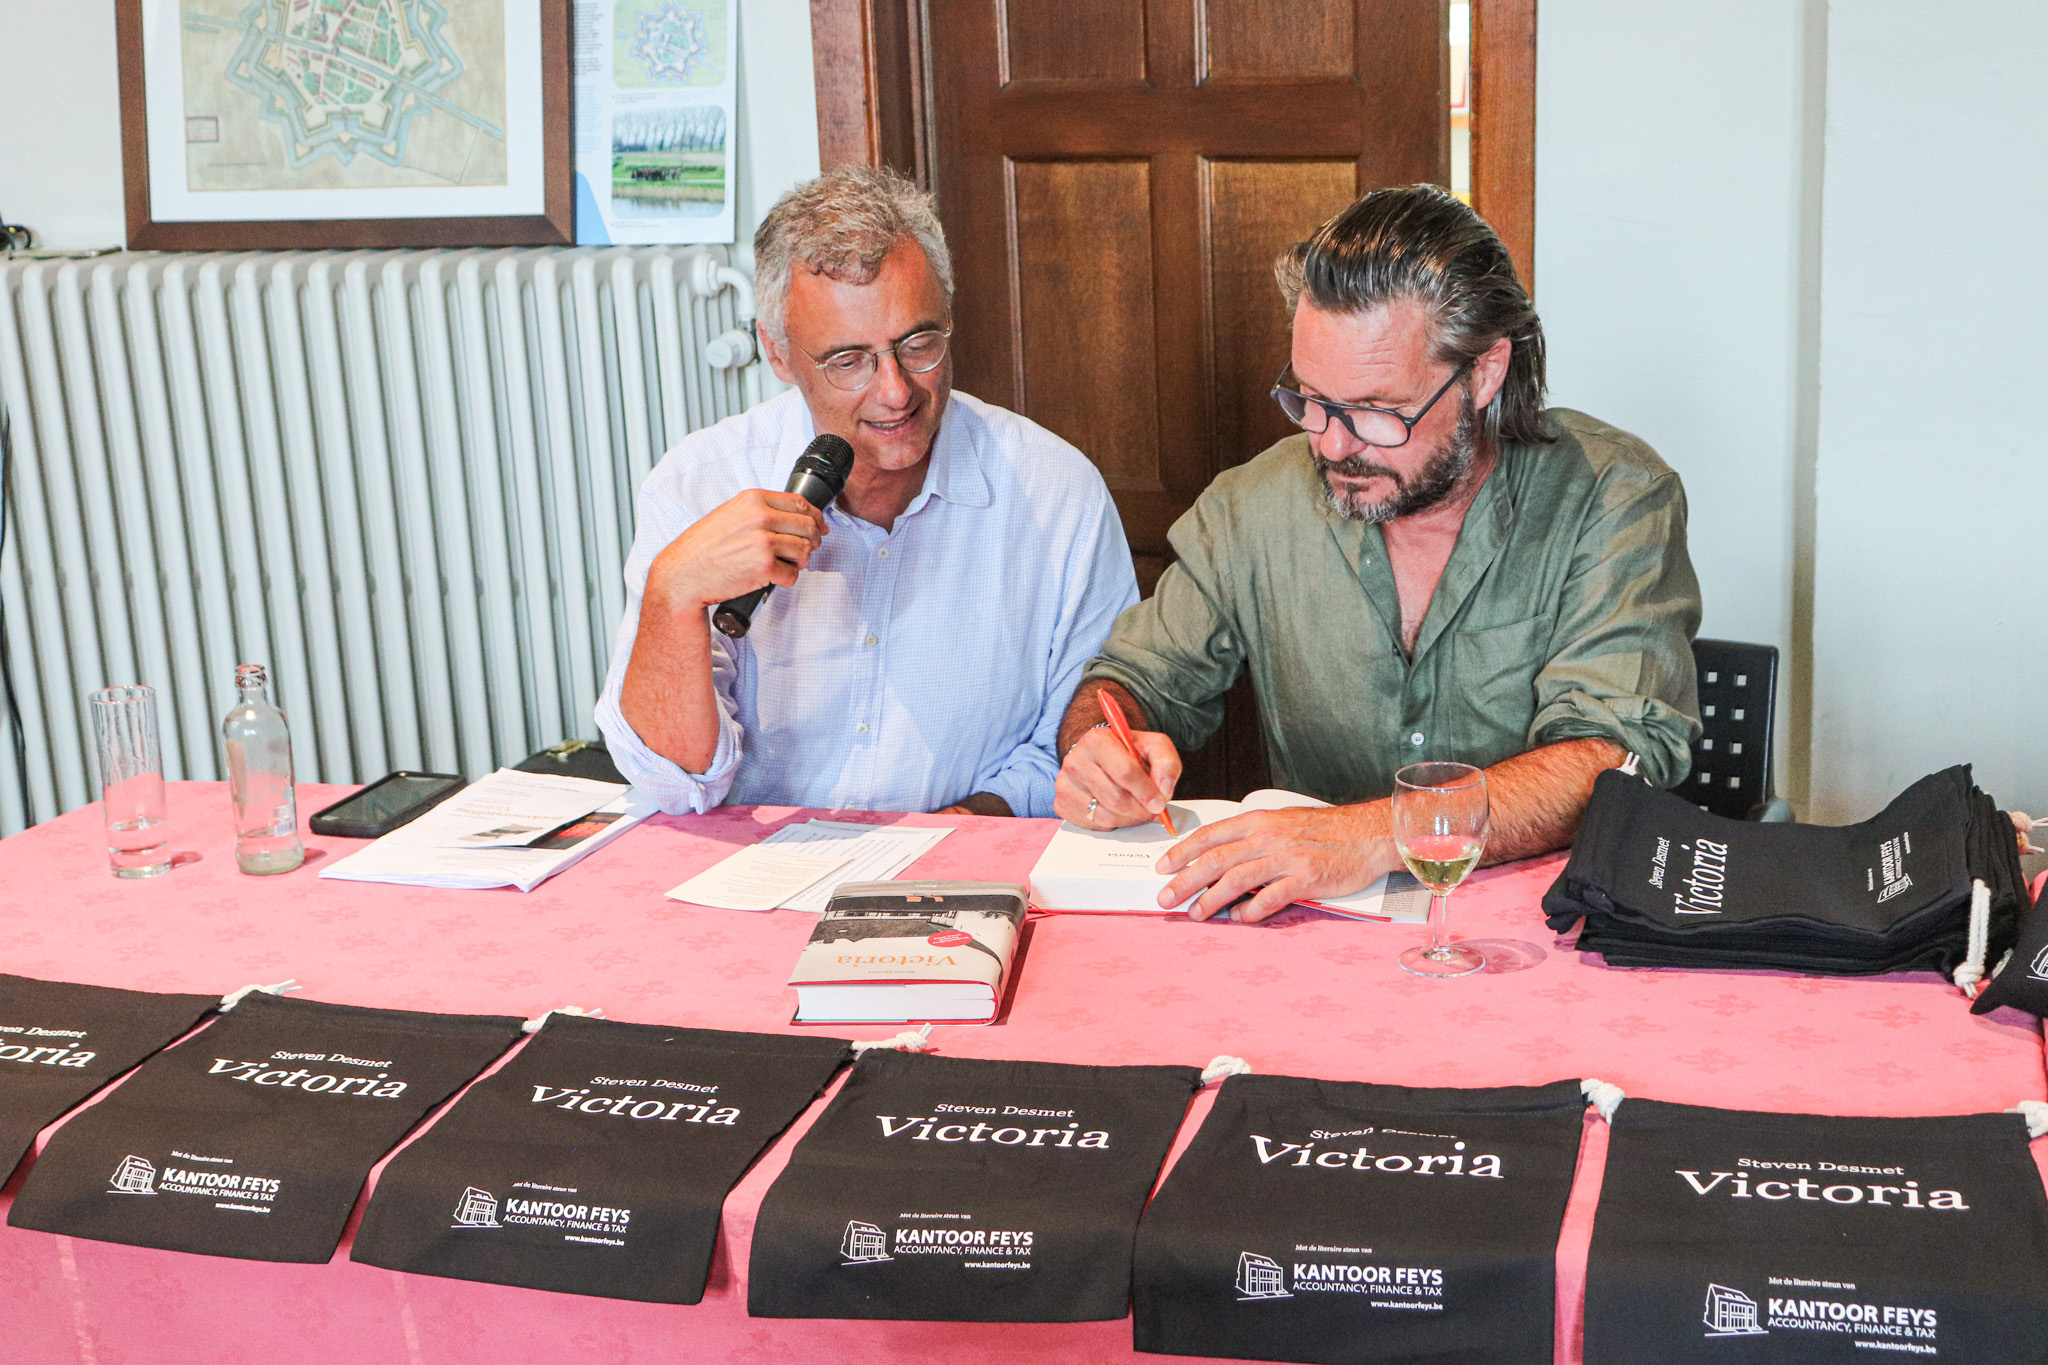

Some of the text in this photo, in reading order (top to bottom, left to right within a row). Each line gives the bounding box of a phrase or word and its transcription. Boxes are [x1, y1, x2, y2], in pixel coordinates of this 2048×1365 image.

[1652, 837, 1670, 867] Desmet
[1673, 838, 1728, 914] Victoria
[837, 955, 958, 967] Victoria
[24, 1027, 87, 1038] Desmet
[271, 1051, 392, 1068] Steven Desmet
[208, 1058, 407, 1098] Victoria
[590, 1076, 719, 1093] Steven Desmet
[531, 1085, 741, 1125] Victoria
[934, 1104, 1075, 1118] Steven Desmet
[876, 1115, 1109, 1149] Victoria
[1309, 1127, 1374, 1140] Steven
[1250, 1135, 1504, 1179] Victoria
[1737, 1158, 1904, 1175] Steven Desmet
[163, 1168, 280, 1193] KANTOOR FEYS
[158, 1183, 218, 1197] ACCOUNTANCY,
[219, 1189, 252, 1199] FINANCE
[1675, 1170, 1970, 1210] Victoria
[506, 1198, 630, 1224] KANTOOR FEYS
[503, 1215, 565, 1228] ACCOUNTANCY,
[567, 1221, 602, 1231] FINANCE
[611, 1225, 627, 1233] TAX
[564, 1235, 625, 1246] www.kantoorfeys.be
[895, 1229, 1034, 1246] KANTOOR FEYS
[893, 1246, 1031, 1255] ACCOUNTANCY, FINANCE & TAX
[964, 1261, 1031, 1270] www.kantoorfeys.be
[1293, 1263, 1443, 1285] KANTOOR FEYS
[1292, 1281, 1442, 1296] ACCOUNTANCY, FINANCE & TAX
[1768, 1277, 1783, 1285] Met
[1784, 1278, 1792, 1286] de
[1793, 1278, 1821, 1288] literaire
[1822, 1281, 1841, 1289] steun
[1371, 1300, 1443, 1311] www.kantoorfeys.be
[1768, 1298, 1937, 1327] KANTOOR FEYS
[1768, 1317, 1936, 1339] ACCOUNTANCY, FINANCE & TAX
[1854, 1340, 1937, 1354] www.kantoorfeys.be
